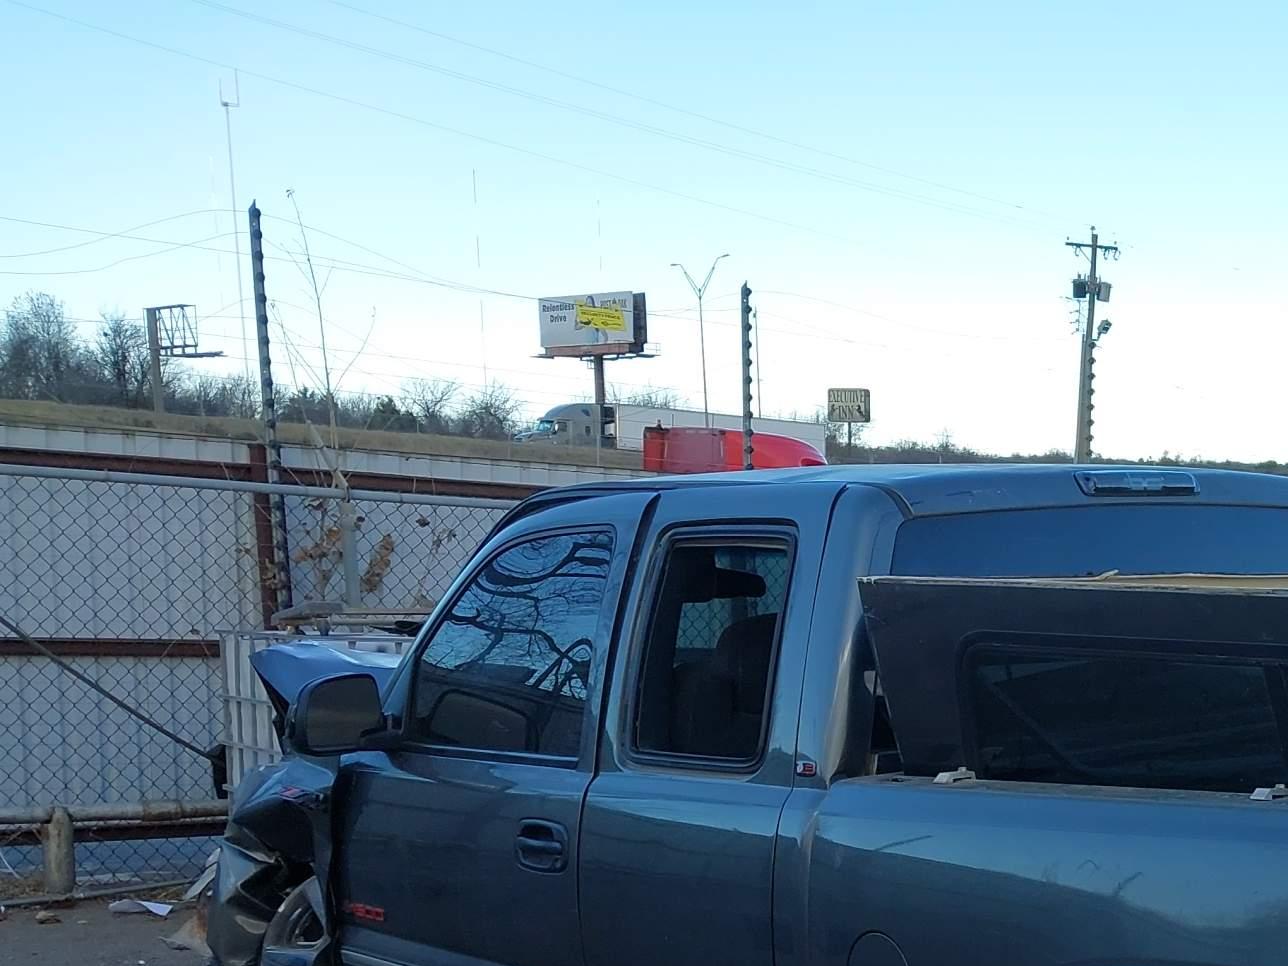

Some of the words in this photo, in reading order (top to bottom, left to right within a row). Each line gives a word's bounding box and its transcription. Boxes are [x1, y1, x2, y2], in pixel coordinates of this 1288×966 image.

[542, 303, 575, 313] Relentless
[549, 314, 567, 323] Drive
[828, 390, 865, 403] EXECUTIVE
[838, 405, 854, 420] INN
